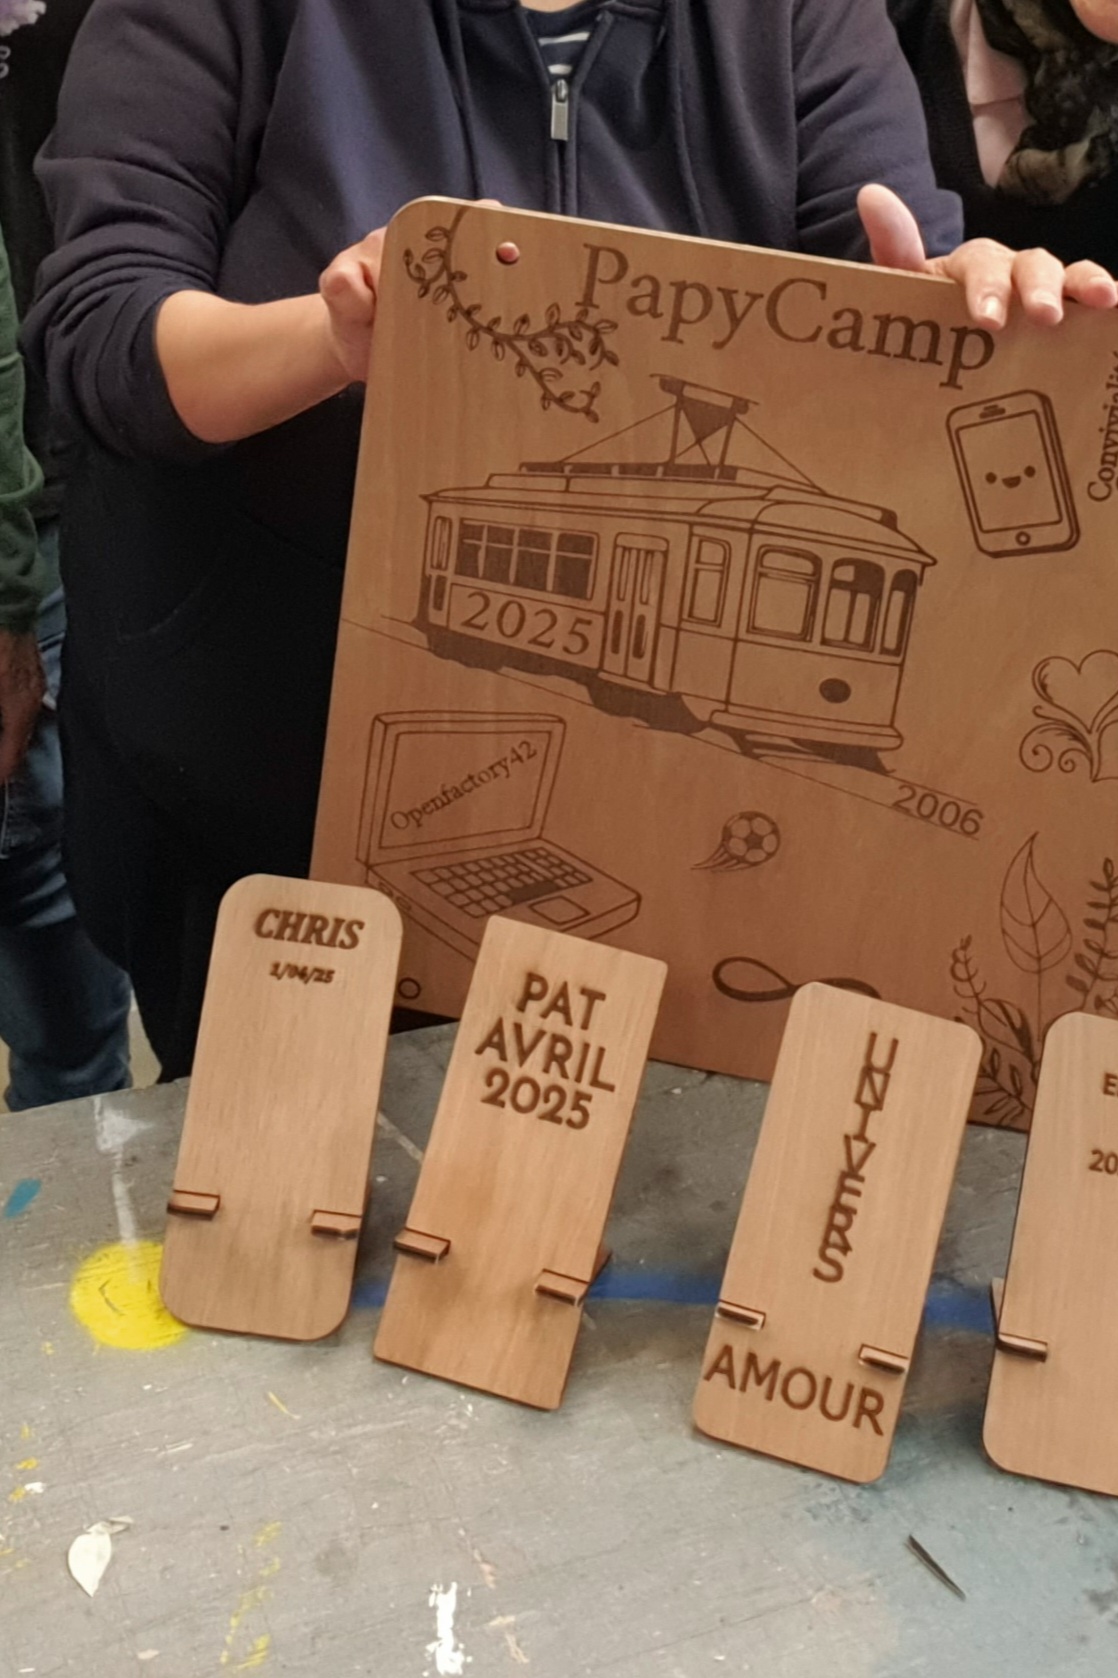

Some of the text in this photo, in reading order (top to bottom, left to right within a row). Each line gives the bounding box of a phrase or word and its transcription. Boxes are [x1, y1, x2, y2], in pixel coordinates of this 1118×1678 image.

[575, 243, 996, 389] PapyCamp
[460, 592, 593, 656] 2025
[391, 741, 537, 830] Openfactory42
[892, 784, 984, 836] 2006
[254, 908, 365, 950] CHRIS
[516, 972, 606, 1033] PAT
[475, 1023, 616, 1093] AVRIL
[480, 1067, 594, 1132] 2025
[812, 1032, 899, 1283] UNIVERS
[704, 1344, 885, 1438] AMOUR
